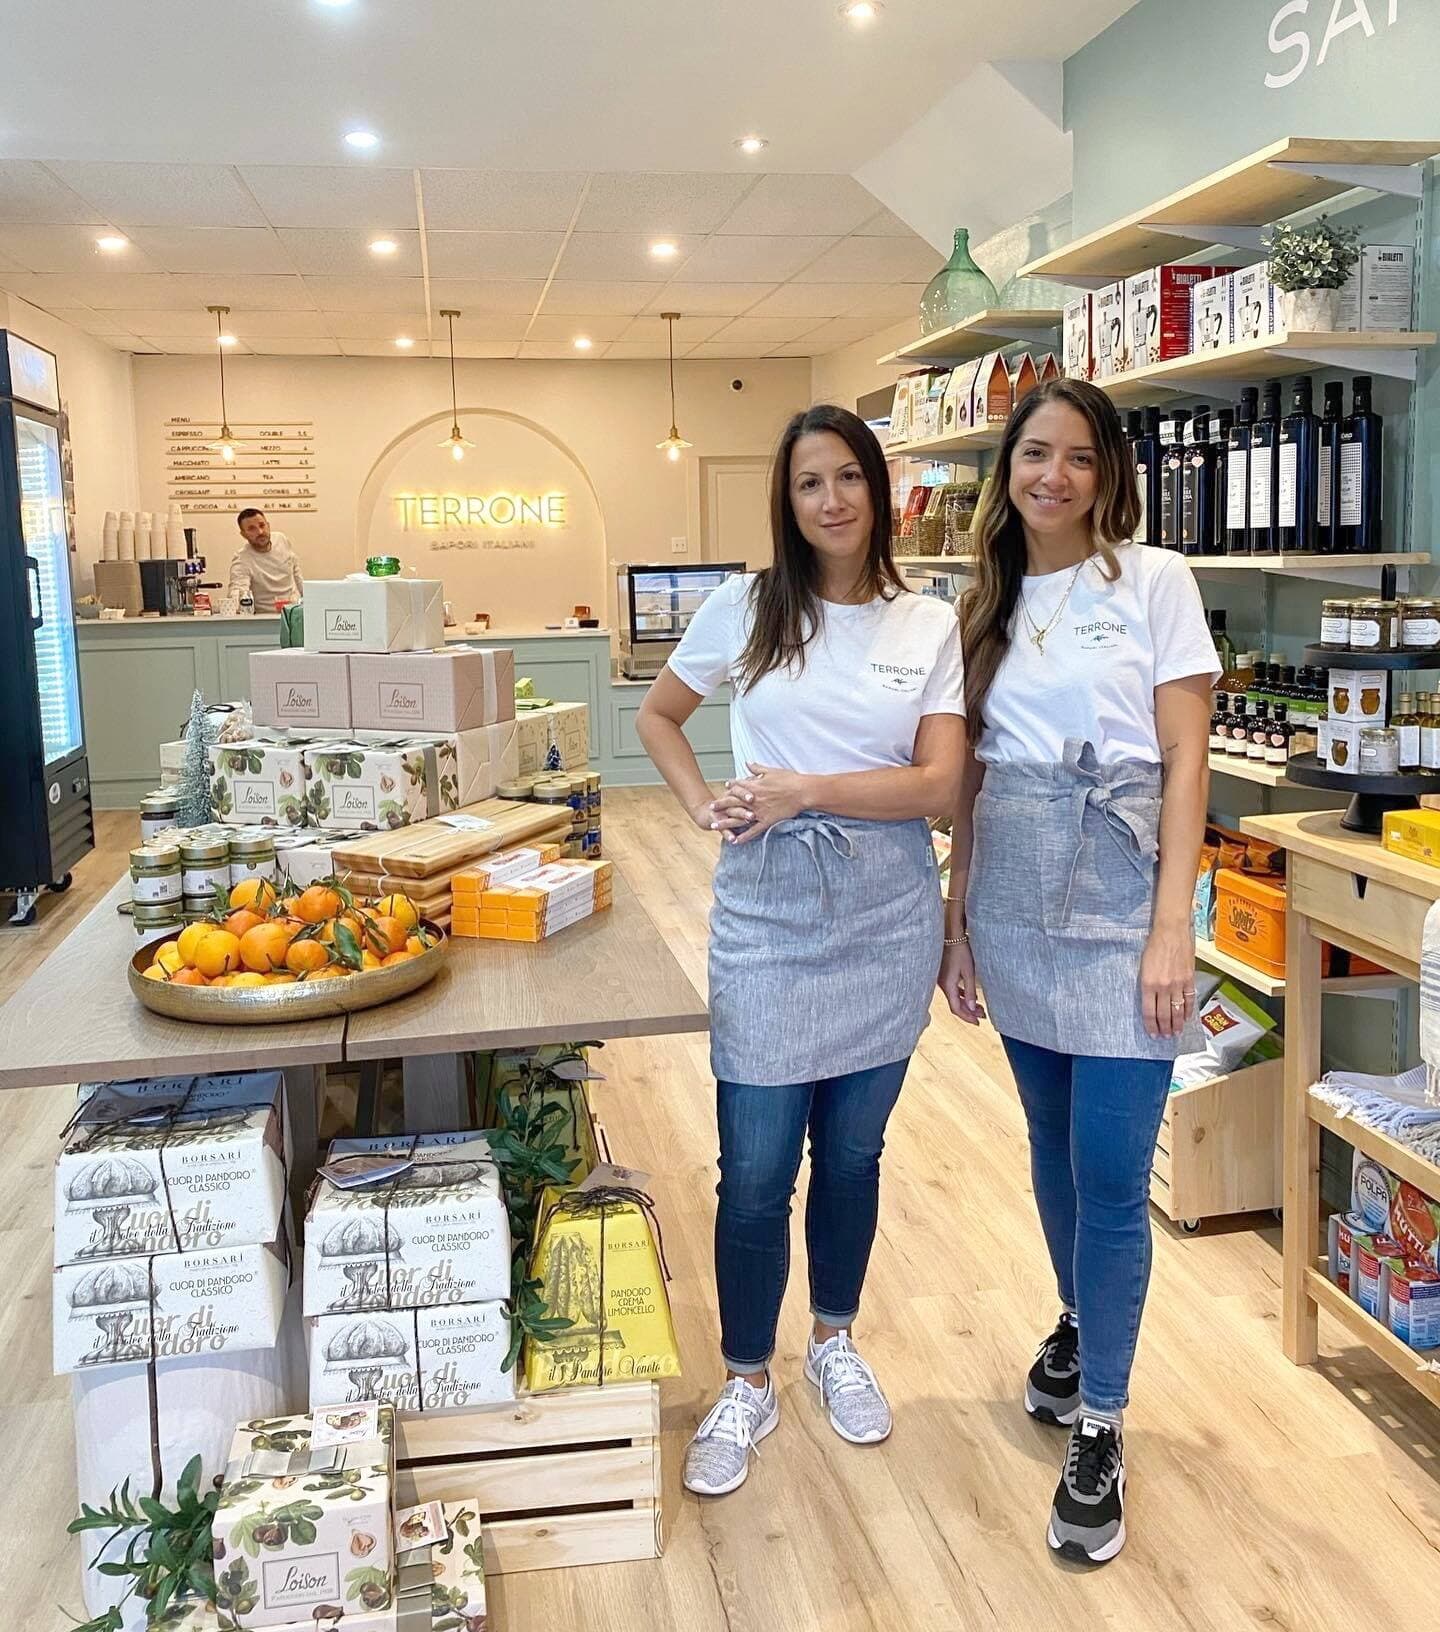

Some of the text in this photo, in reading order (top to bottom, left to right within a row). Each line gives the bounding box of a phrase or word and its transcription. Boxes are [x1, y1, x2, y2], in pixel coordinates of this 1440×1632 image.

[1264, 0, 1398, 88] SA
[1176, 273, 1202, 285] BIALETTI
[394, 496, 566, 531] TERRONE
[430, 540, 536, 551] SAPORI ITALIANI
[1072, 621, 1127, 636] TERRONE
[870, 663, 926, 676] TERRONE
[283, 688, 312, 707] Loison
[386, 689, 416, 708] Loison
[241, 786, 268, 804] Loison
[341, 791, 368, 809] Loison
[137, 1077, 242, 1093] BORARI
[168, 1170, 250, 1186] CUOR DI PANDORO
[188, 1181, 230, 1193] CLASSICO
[1360, 1175, 1388, 1204] POLPA
[175, 1216, 236, 1234] Tradizione
[412, 1230, 490, 1245] CUOR DI PANDORO
[431, 1241, 471, 1252] CLASSICO
[169, 1273, 253, 1291] CUOR DI PANDORO
[421, 1274, 477, 1291] Tradizione
[191, 1285, 233, 1298] CLASSICO
[610, 1287, 651, 1298] PANDORO
[618, 1297, 644, 1307] CREMA
[607, 1304, 655, 1317] LIMONCELLO
[147, 1328, 171, 1343] dlla
[178, 1321, 239, 1339] Tradizione
[442, 1338, 450, 1347] DI
[453, 1333, 494, 1345] PANDORO
[436, 1344, 475, 1355] CLASSICO
[561, 1359, 612, 1382] Pandro
[425, 1376, 481, 1394] Tradizione
[275, 1565, 329, 1594] Loison
